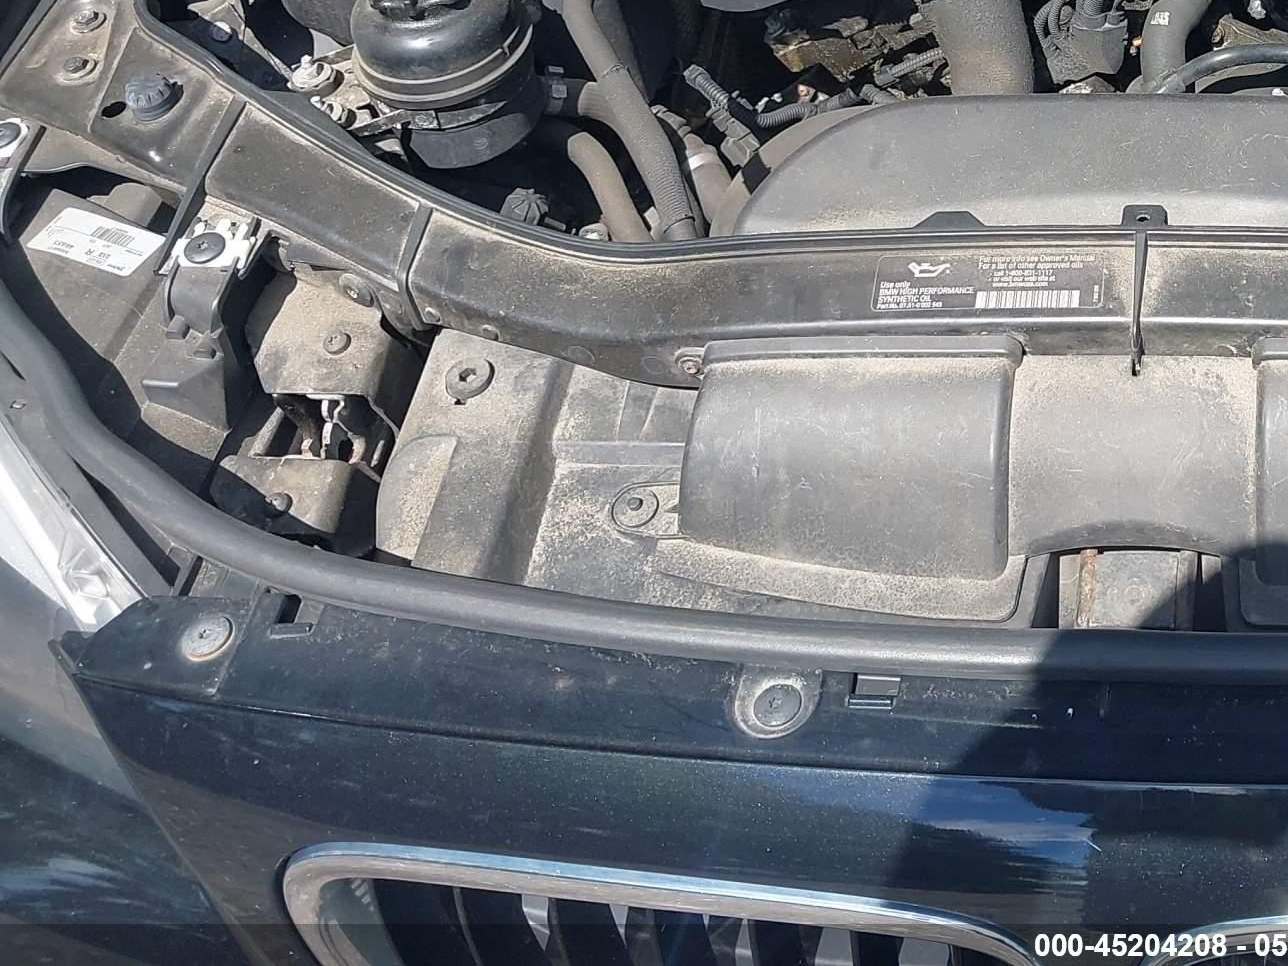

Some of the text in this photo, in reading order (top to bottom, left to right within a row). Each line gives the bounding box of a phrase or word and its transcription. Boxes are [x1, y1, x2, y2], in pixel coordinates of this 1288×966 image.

[1040, 253, 1069, 262] Owner's
[978, 262, 990, 270] For
[1017, 261, 1036, 269] other
[1037, 261, 1070, 270] approved
[895, 280, 911, 290] only
[879, 286, 975, 296] BMW HIGH PERFORMANCE
[877, 295, 932, 304] SYNTHETIC OIL
